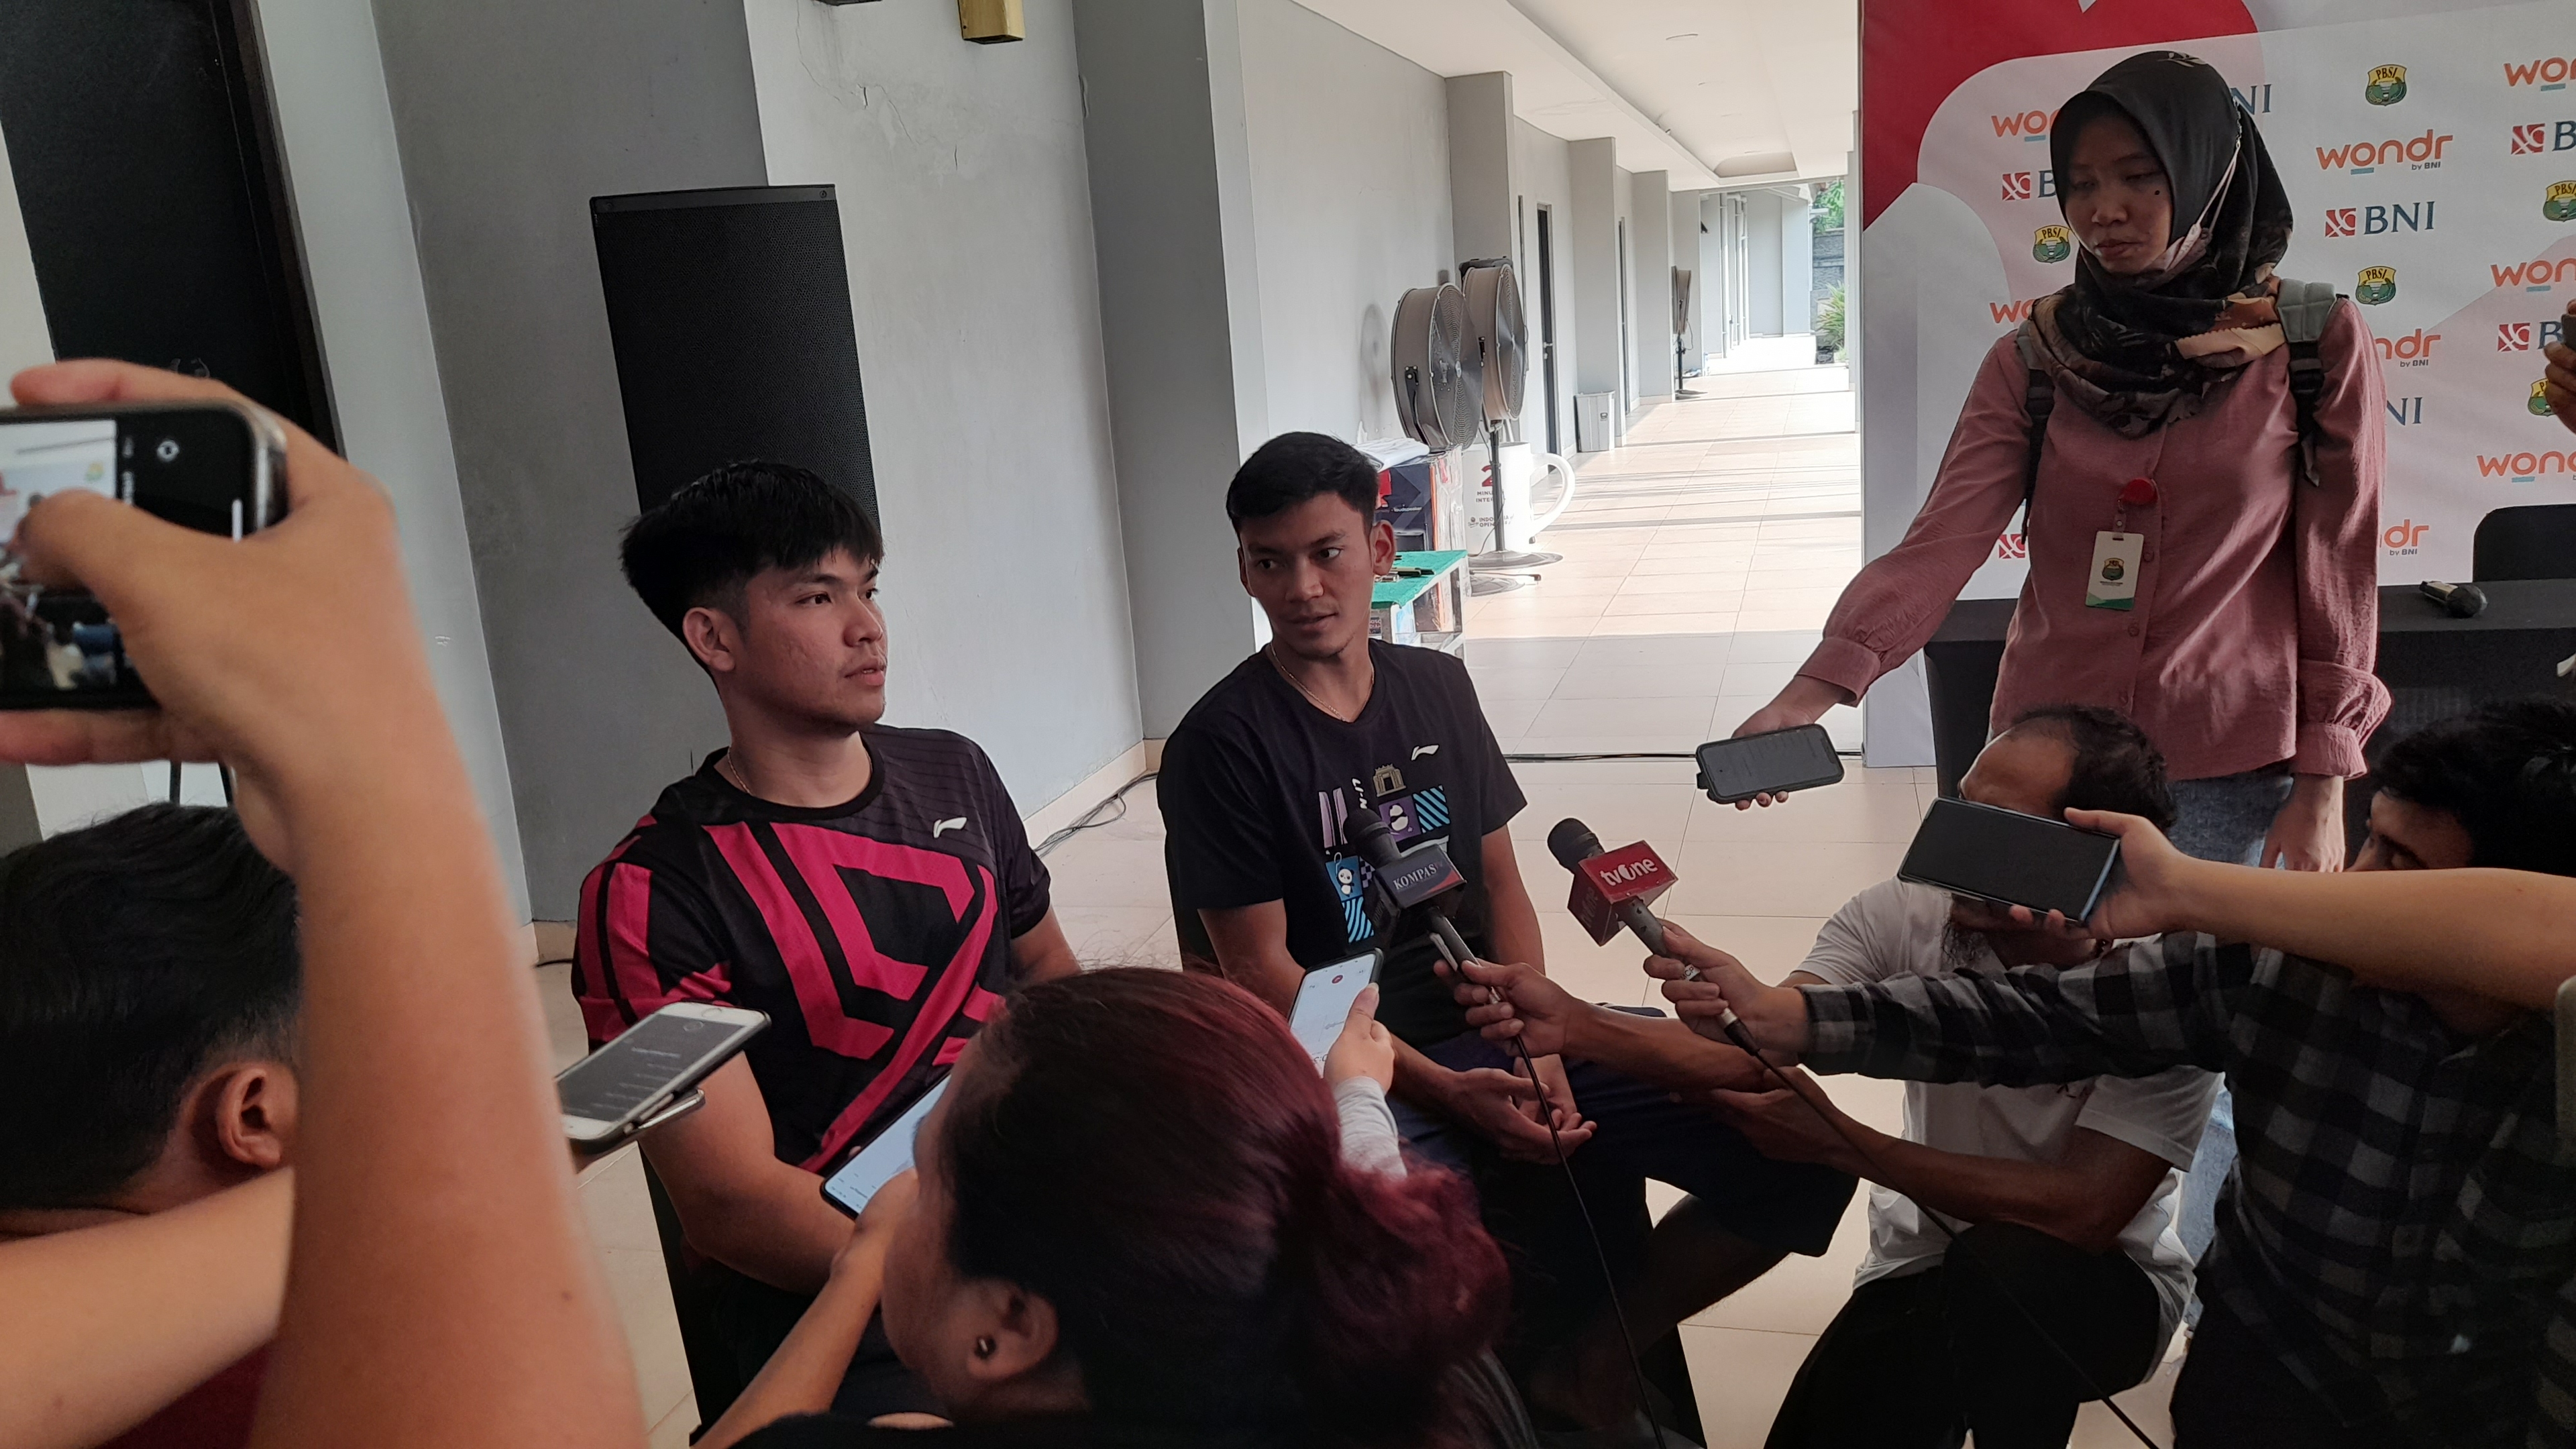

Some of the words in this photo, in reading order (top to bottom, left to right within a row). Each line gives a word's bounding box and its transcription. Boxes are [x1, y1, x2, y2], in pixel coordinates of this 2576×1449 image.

[2375, 66, 2398, 80] PBSI
[2504, 57, 2576, 87] wo
[1991, 108, 2061, 138] wo
[2316, 129, 2453, 170] wondr
[2424, 161, 2441, 169] BNI
[2363, 201, 2435, 235] BNI
[2041, 227, 2061, 239] PBSI
[2365, 268, 2387, 280] PBSI
[2412, 359, 2429, 367] BNI
[1393, 863, 1437, 890] KOMPAS
[1599, 858, 1659, 887] tvOne
